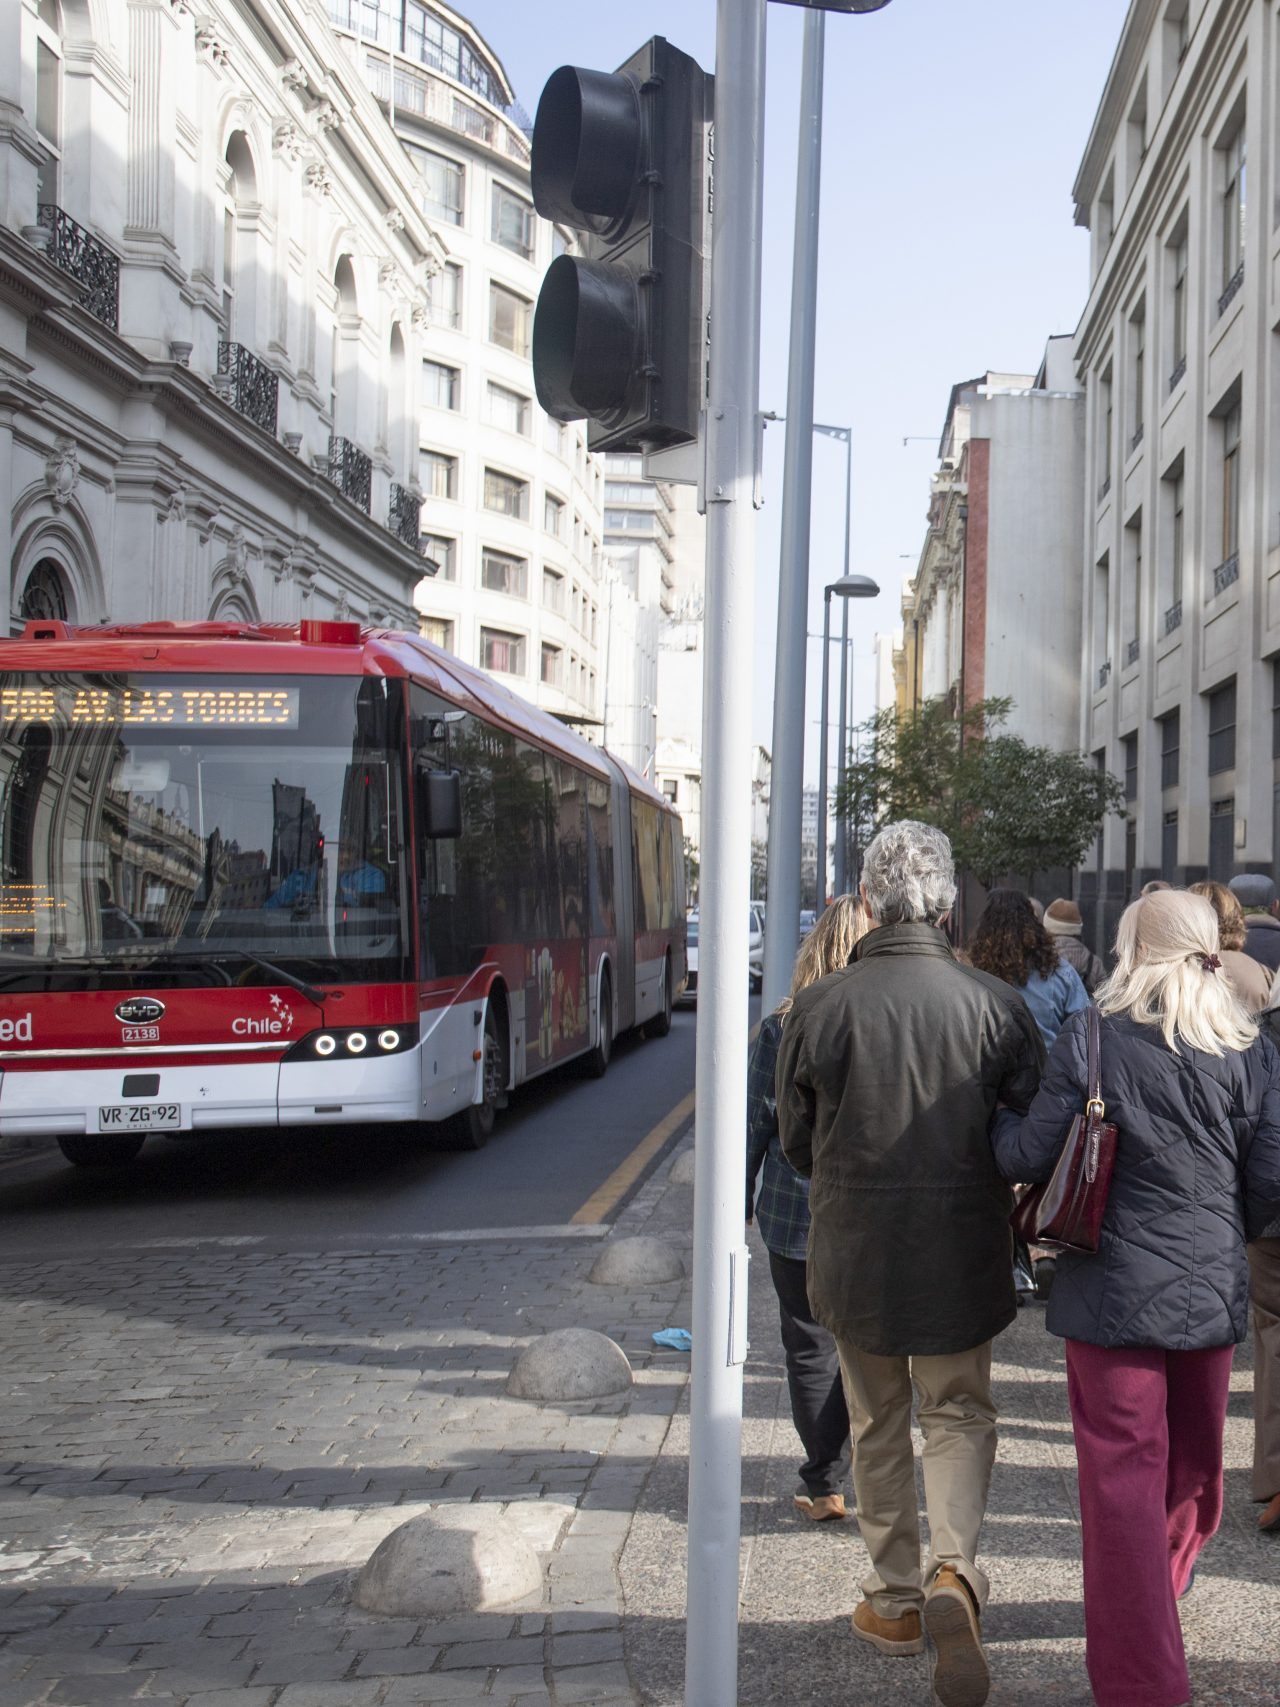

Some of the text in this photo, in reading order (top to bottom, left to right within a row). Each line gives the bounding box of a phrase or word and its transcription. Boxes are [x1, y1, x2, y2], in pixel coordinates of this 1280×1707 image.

[124, 691, 174, 722] LAS
[182, 691, 289, 723] TORRES
[120, 1005, 160, 1017] BYD
[231, 1017, 283, 1034] Chile
[125, 1028, 157, 1041] 2138
